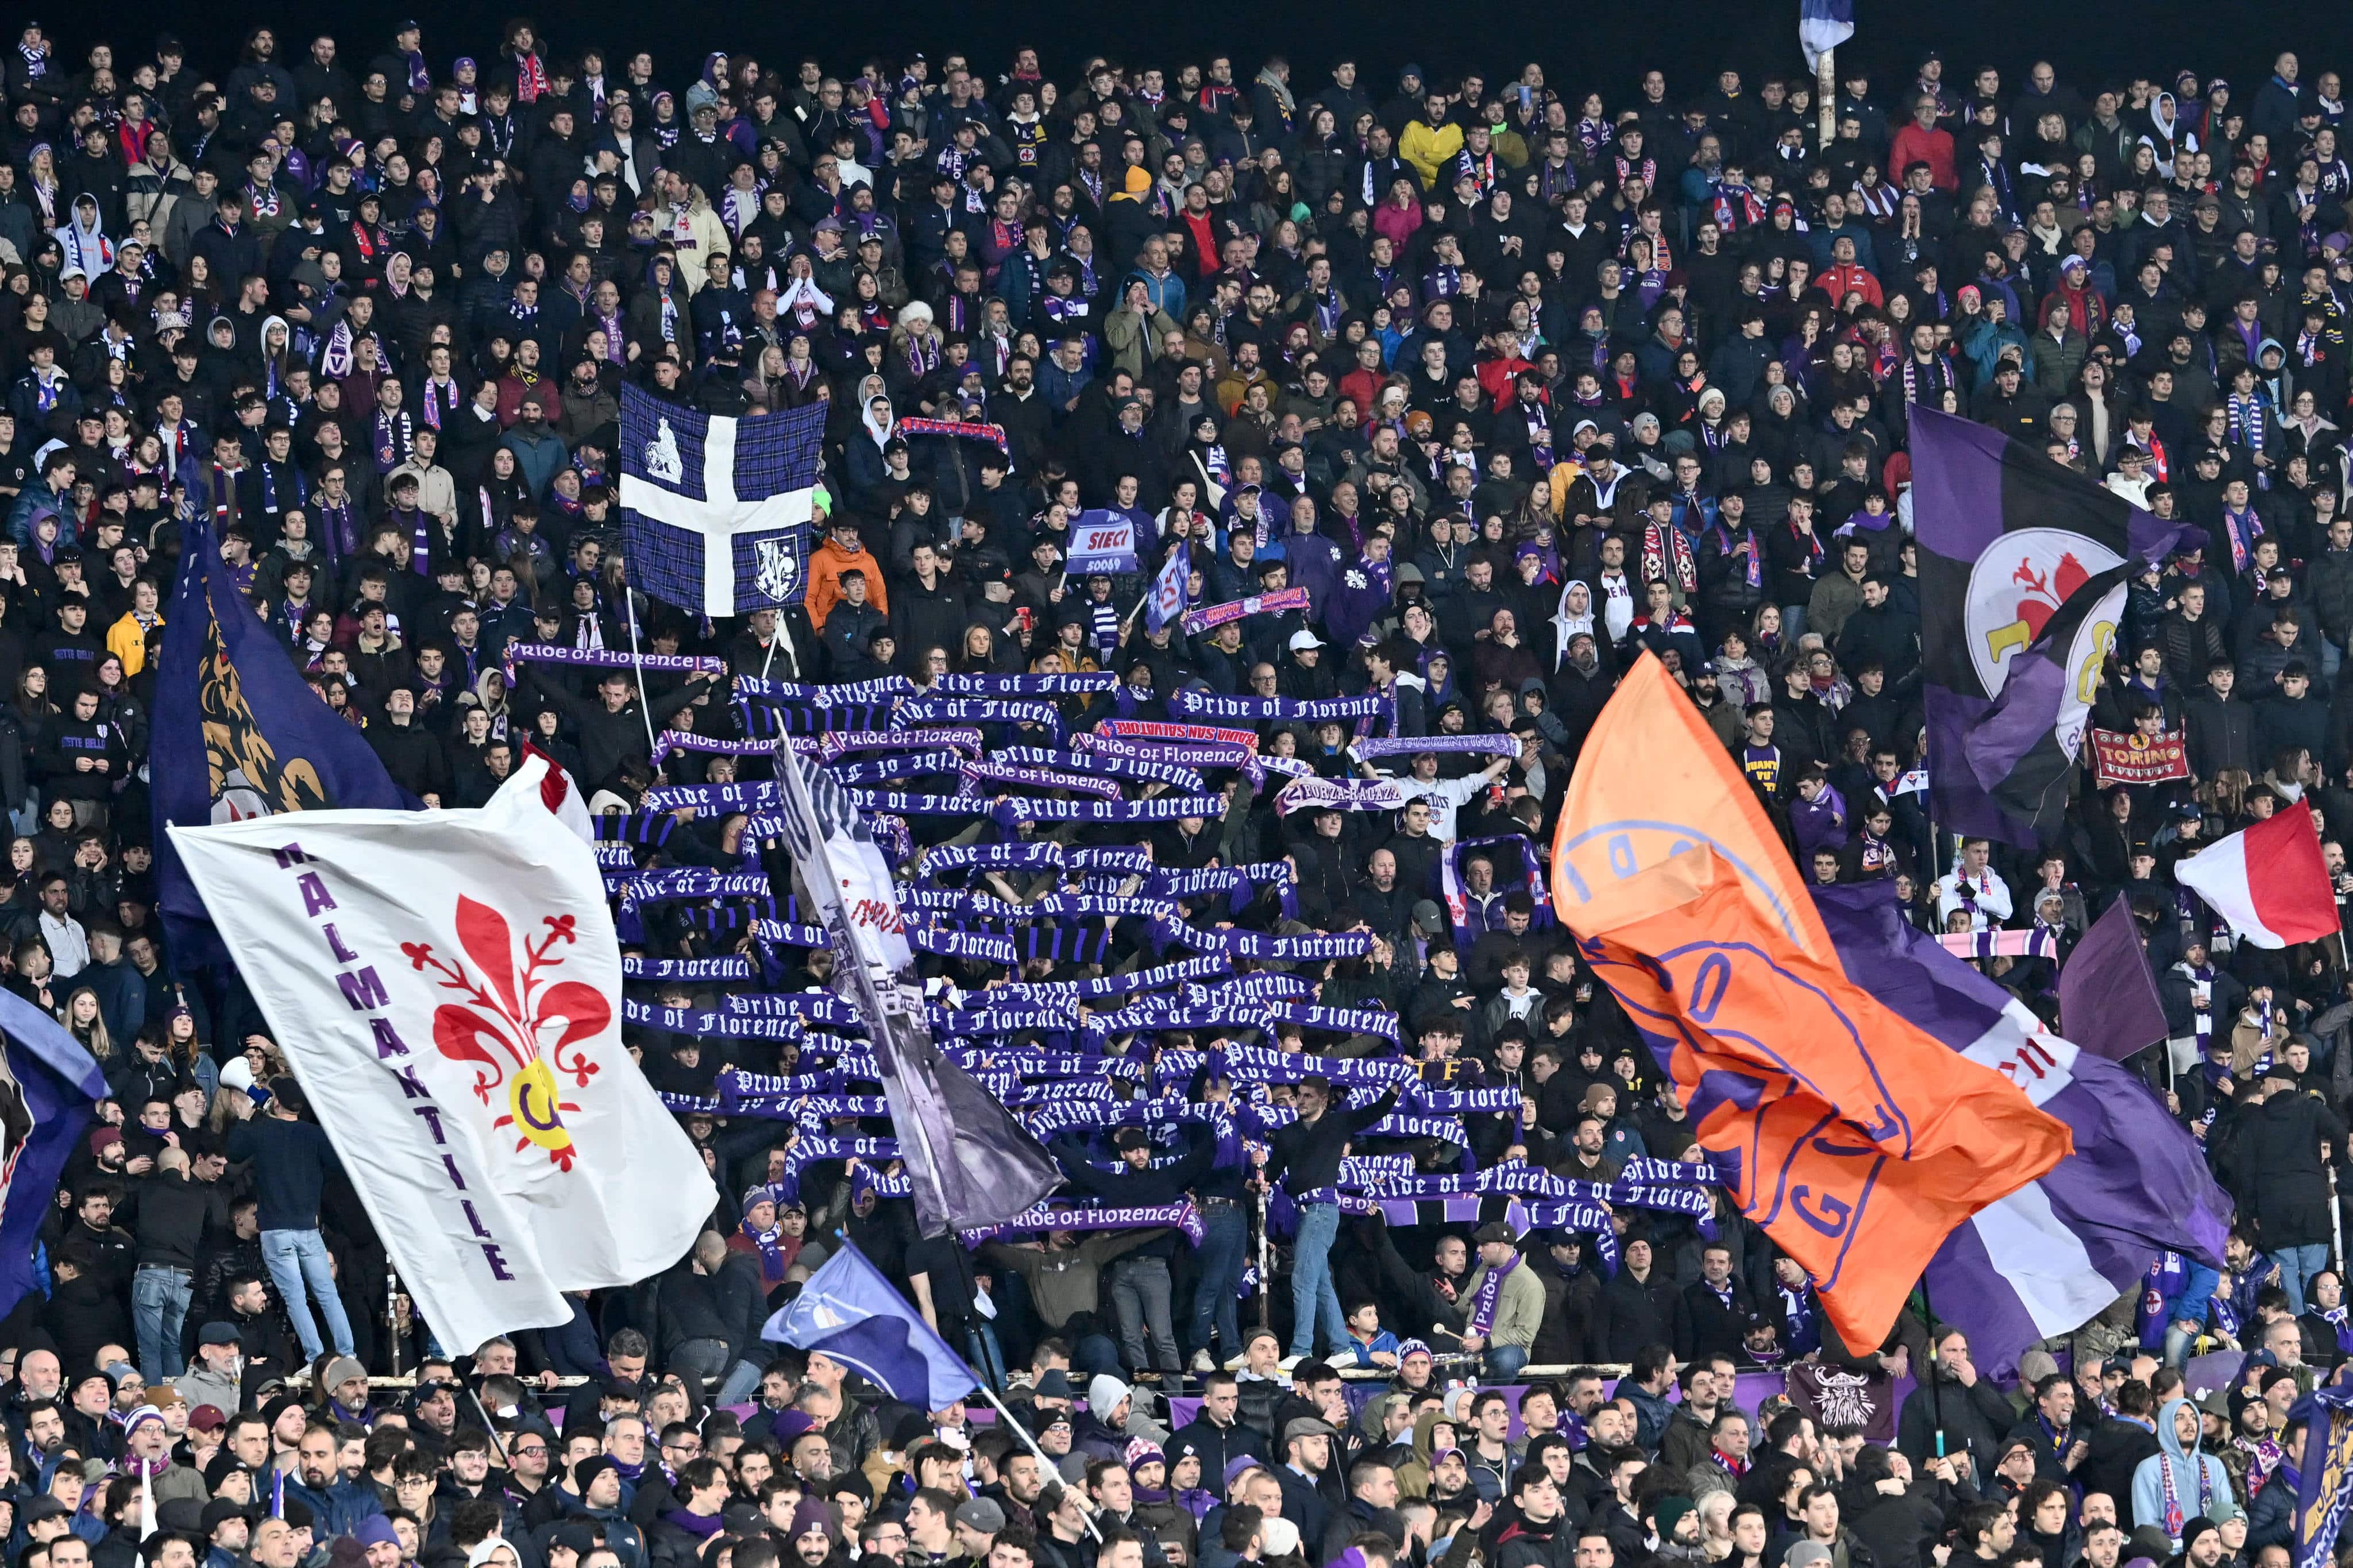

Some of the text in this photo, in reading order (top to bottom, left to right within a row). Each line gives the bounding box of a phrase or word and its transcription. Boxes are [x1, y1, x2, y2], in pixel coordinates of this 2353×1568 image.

[1087, 530, 1129, 550] SIECI
[1086, 558, 1121, 571] 50069
[935, 674, 985, 690] ride
[1000, 675, 1022, 692] of
[948, 700, 967, 718] of
[1185, 692, 1379, 718] Pride of Florence
[836, 731, 888, 747] Pride
[892, 732, 911, 744] of
[1113, 721, 1186, 738] SALVATORE
[1187, 725, 1216, 740] SAN
[1084, 733, 1244, 763] Pride of Florence
[1405, 736, 1498, 748] FIORENTINA
[2102, 746, 2181, 764] TORINO
[1019, 769, 1037, 781] of
[1042, 770, 1116, 793] Florence
[1305, 785, 1344, 802] FORZA
[1009, 796, 1080, 820] Pride
[991, 843, 1012, 860] of
[1240, 934, 1259, 955] of
[1272, 936, 1365, 957] Florence
[1125, 954, 1221, 991] Florence
[730, 995, 835, 1020] Pride of
[665, 1009, 686, 1029] of
[698, 1013, 799, 1040] Florence
[1224, 1041, 1291, 1068] Pride
[1439, 1174, 1461, 1194] of
[1012, 1207, 1181, 1228] ride of Florence
[1476, 1270, 1497, 1326] Pride
